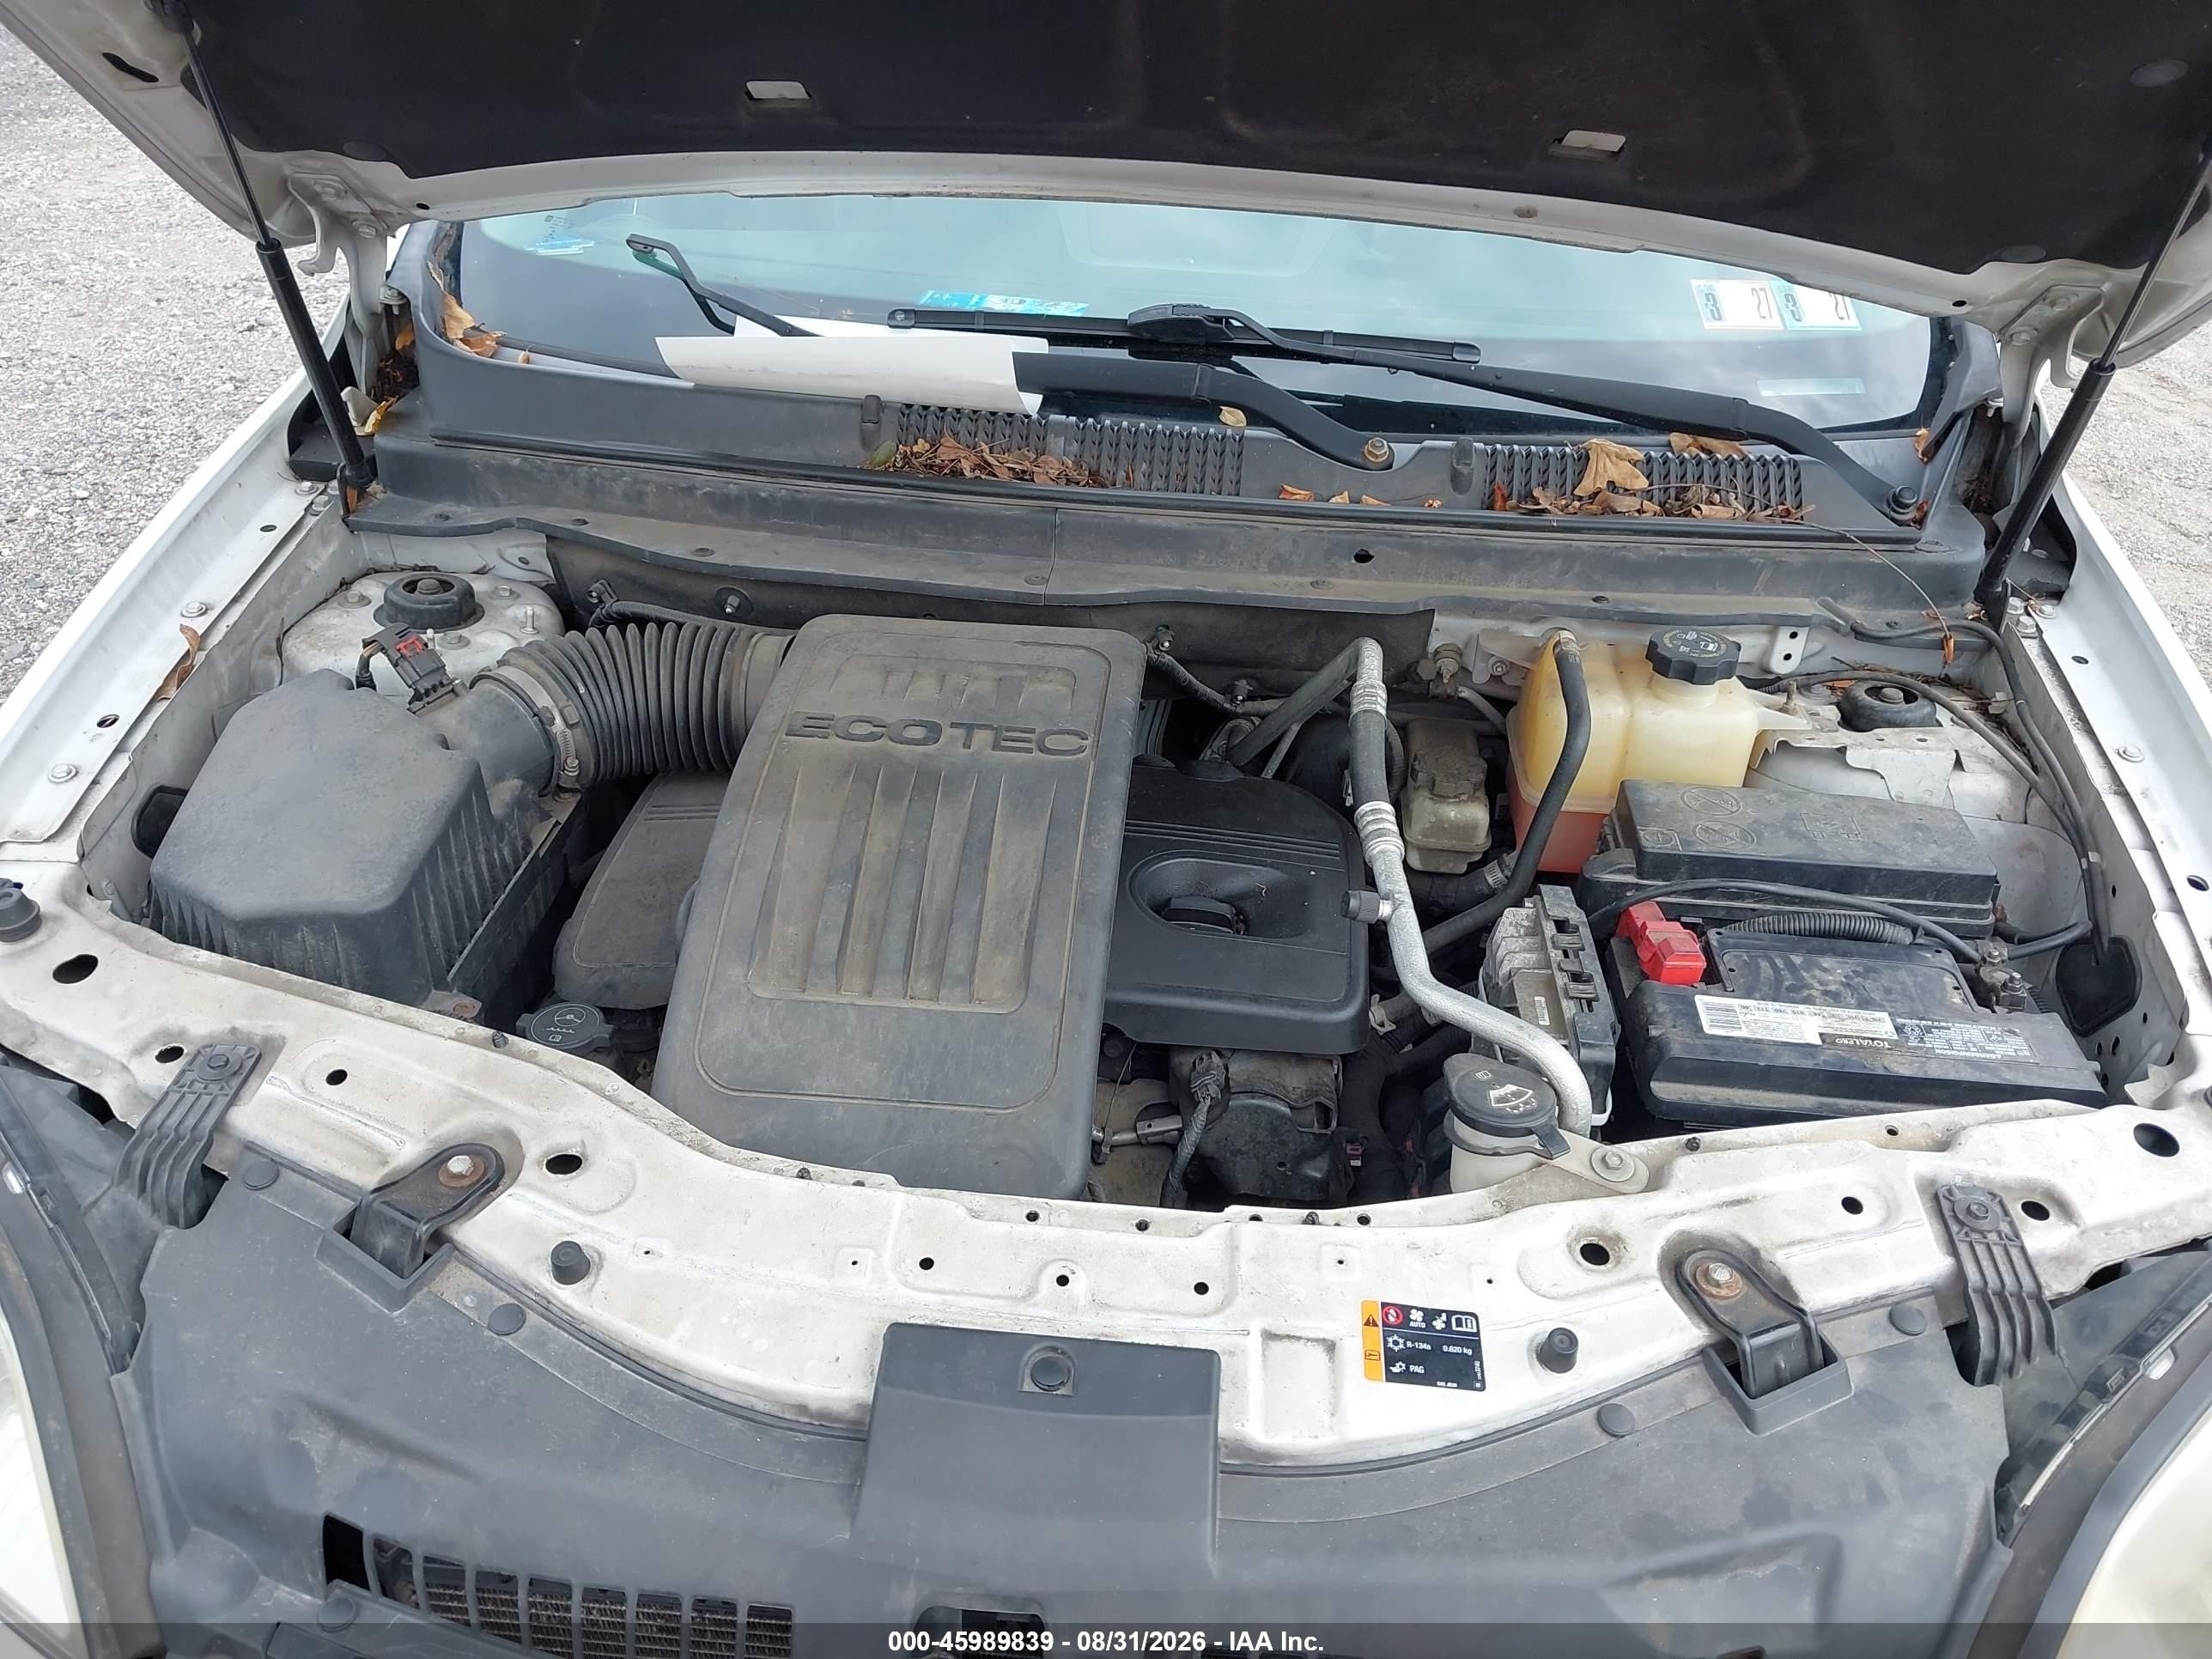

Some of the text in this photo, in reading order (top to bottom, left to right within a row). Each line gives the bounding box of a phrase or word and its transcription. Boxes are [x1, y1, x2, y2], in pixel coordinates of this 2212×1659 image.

[785, 711, 1090, 757] ECOTEC
[1406, 1340, 1473, 1356] R-134a 0.620 kg
[1409, 1365, 1425, 1374] PAG
